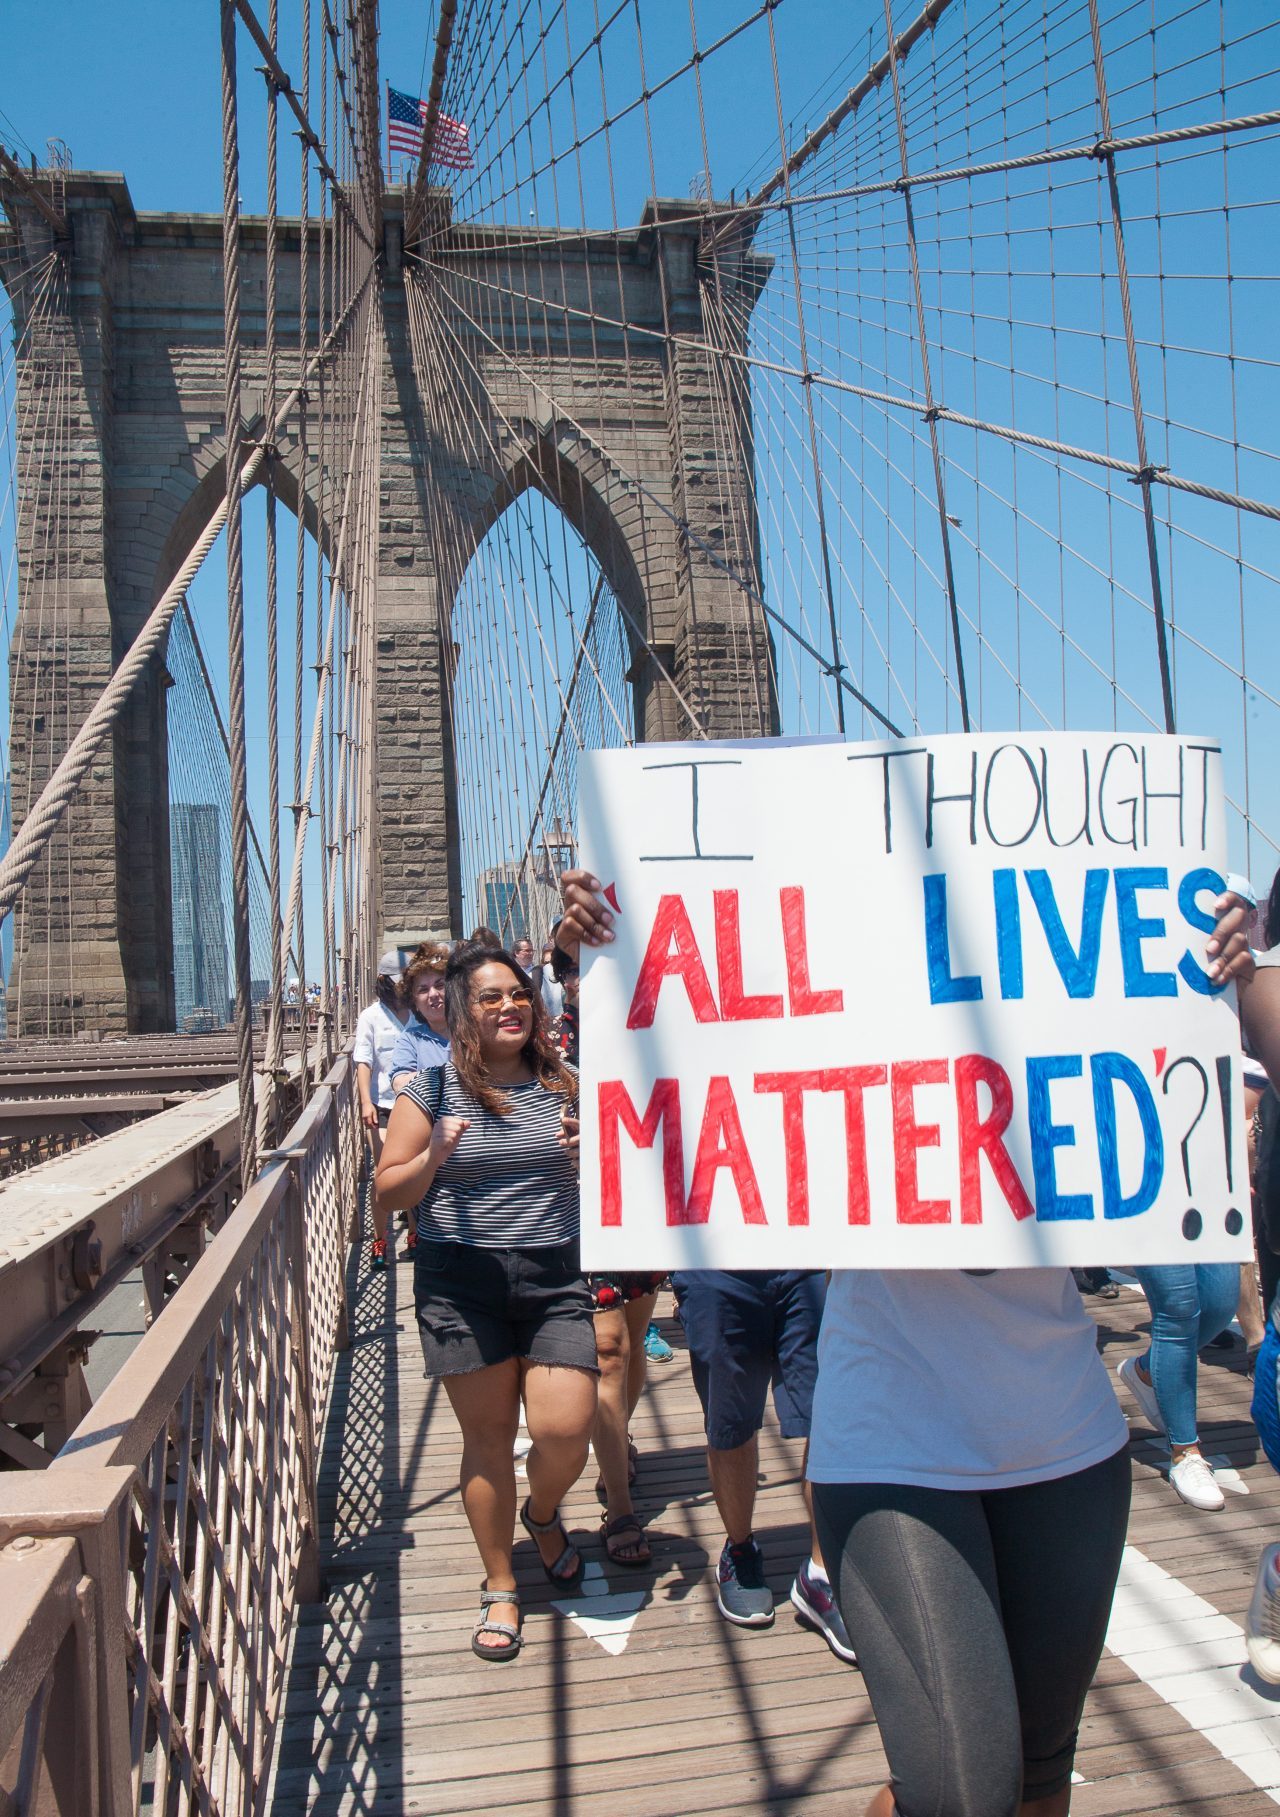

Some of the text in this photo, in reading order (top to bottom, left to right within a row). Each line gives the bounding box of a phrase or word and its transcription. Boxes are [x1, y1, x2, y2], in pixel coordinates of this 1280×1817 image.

[640, 743, 1222, 861] I THOUGHT
[923, 867, 1229, 1005] LIVES
